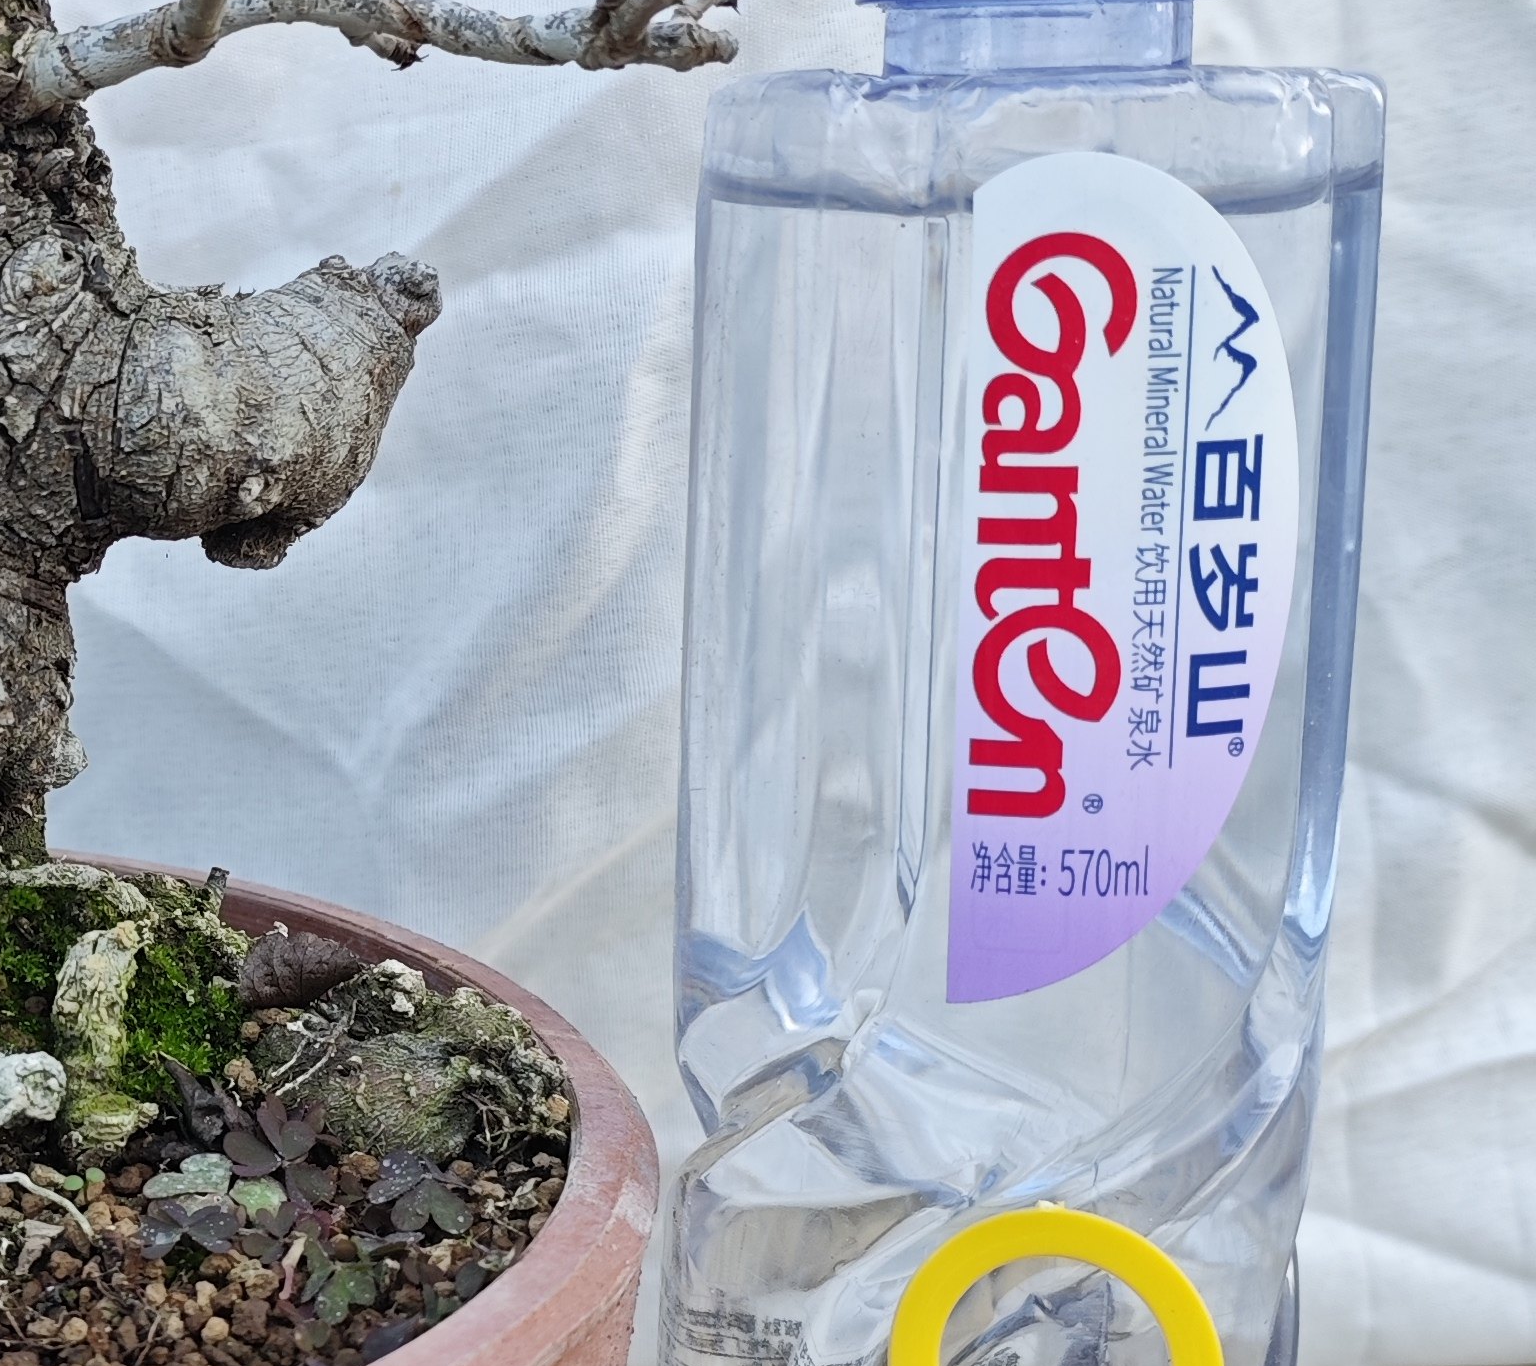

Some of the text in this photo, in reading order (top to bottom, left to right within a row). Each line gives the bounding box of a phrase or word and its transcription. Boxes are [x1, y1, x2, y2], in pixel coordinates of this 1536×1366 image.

[967, 231, 1137, 819] Ganten
[1126, 266, 1185, 771] Natural Mineral Water 饮用天然矿泉水
[1186, 433, 1264, 738] 百岁山
[1057, 844, 1150, 897] 570ml
